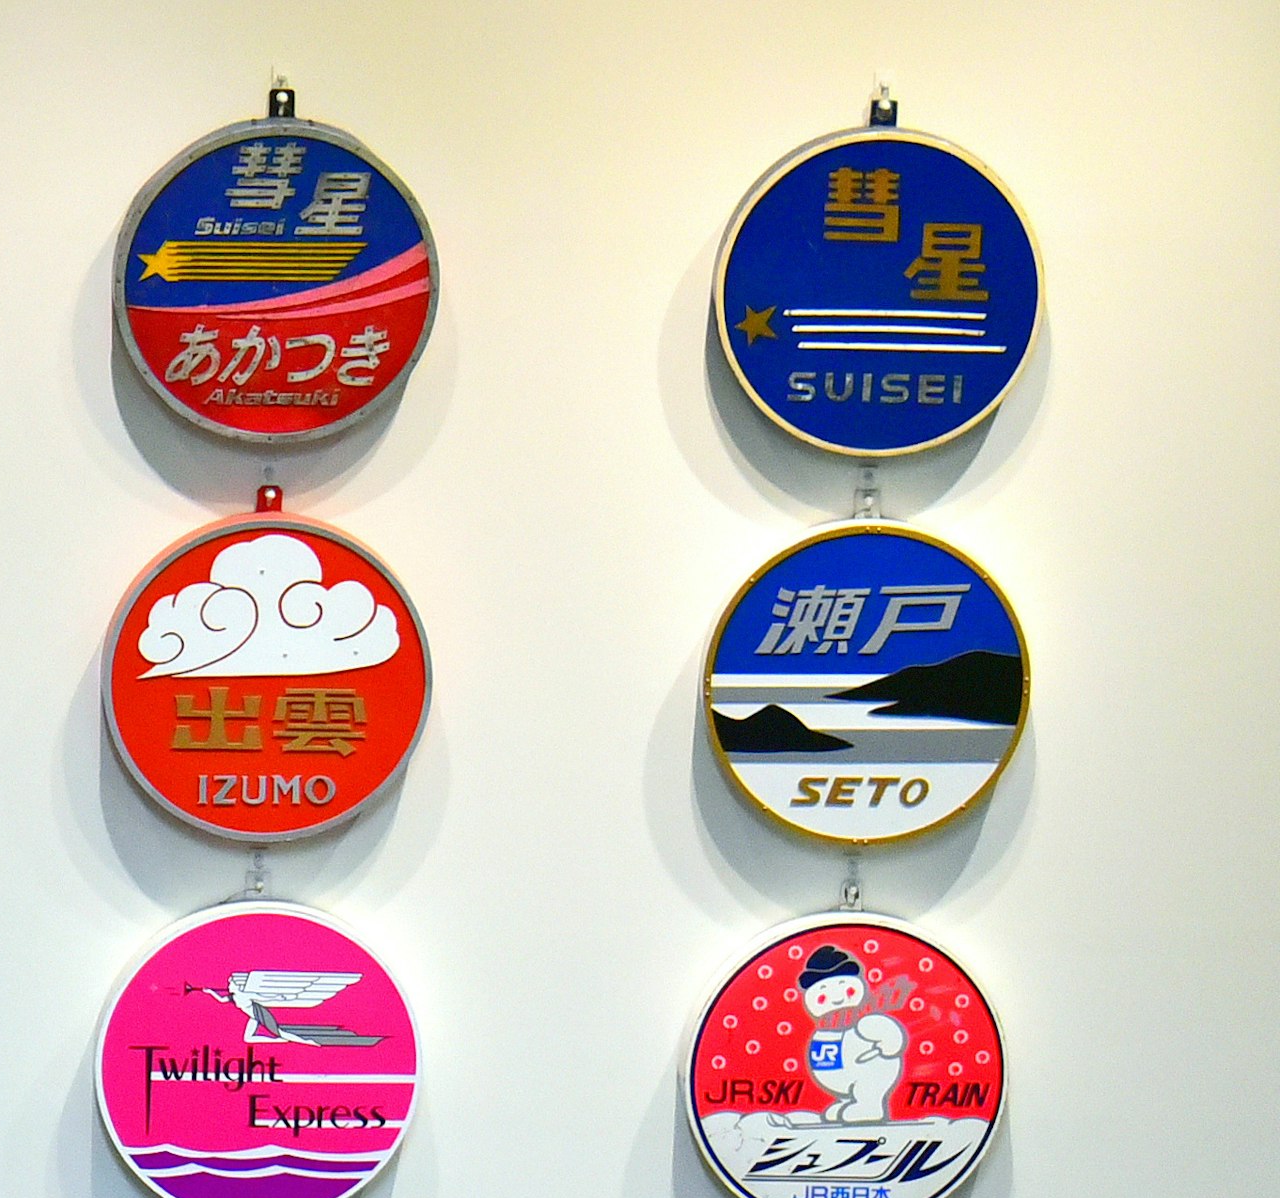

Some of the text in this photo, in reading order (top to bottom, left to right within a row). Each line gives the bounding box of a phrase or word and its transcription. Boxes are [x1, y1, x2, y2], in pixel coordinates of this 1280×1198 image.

[225, 142, 371, 236] 彗星
[194, 216, 286, 236] Suisei
[824, 167, 989, 302] 彗星
[165, 324, 390, 386] あかつき
[203, 388, 341, 407] Akatsuki
[786, 371, 964, 404] SUISEI
[754, 584, 971, 655] 瀬戸
[170, 686, 368, 757] 出雲
[197, 774, 337, 805] IZUMO
[790, 776, 930, 808] SETO
[811, 1044, 839, 1062] JR
[128, 1045, 283, 1136] Twilight
[705, 1079, 991, 1107] JR SKI TRAIN
[248, 1094, 386, 1137] Express
[746, 1137, 972, 1183] シュプール
